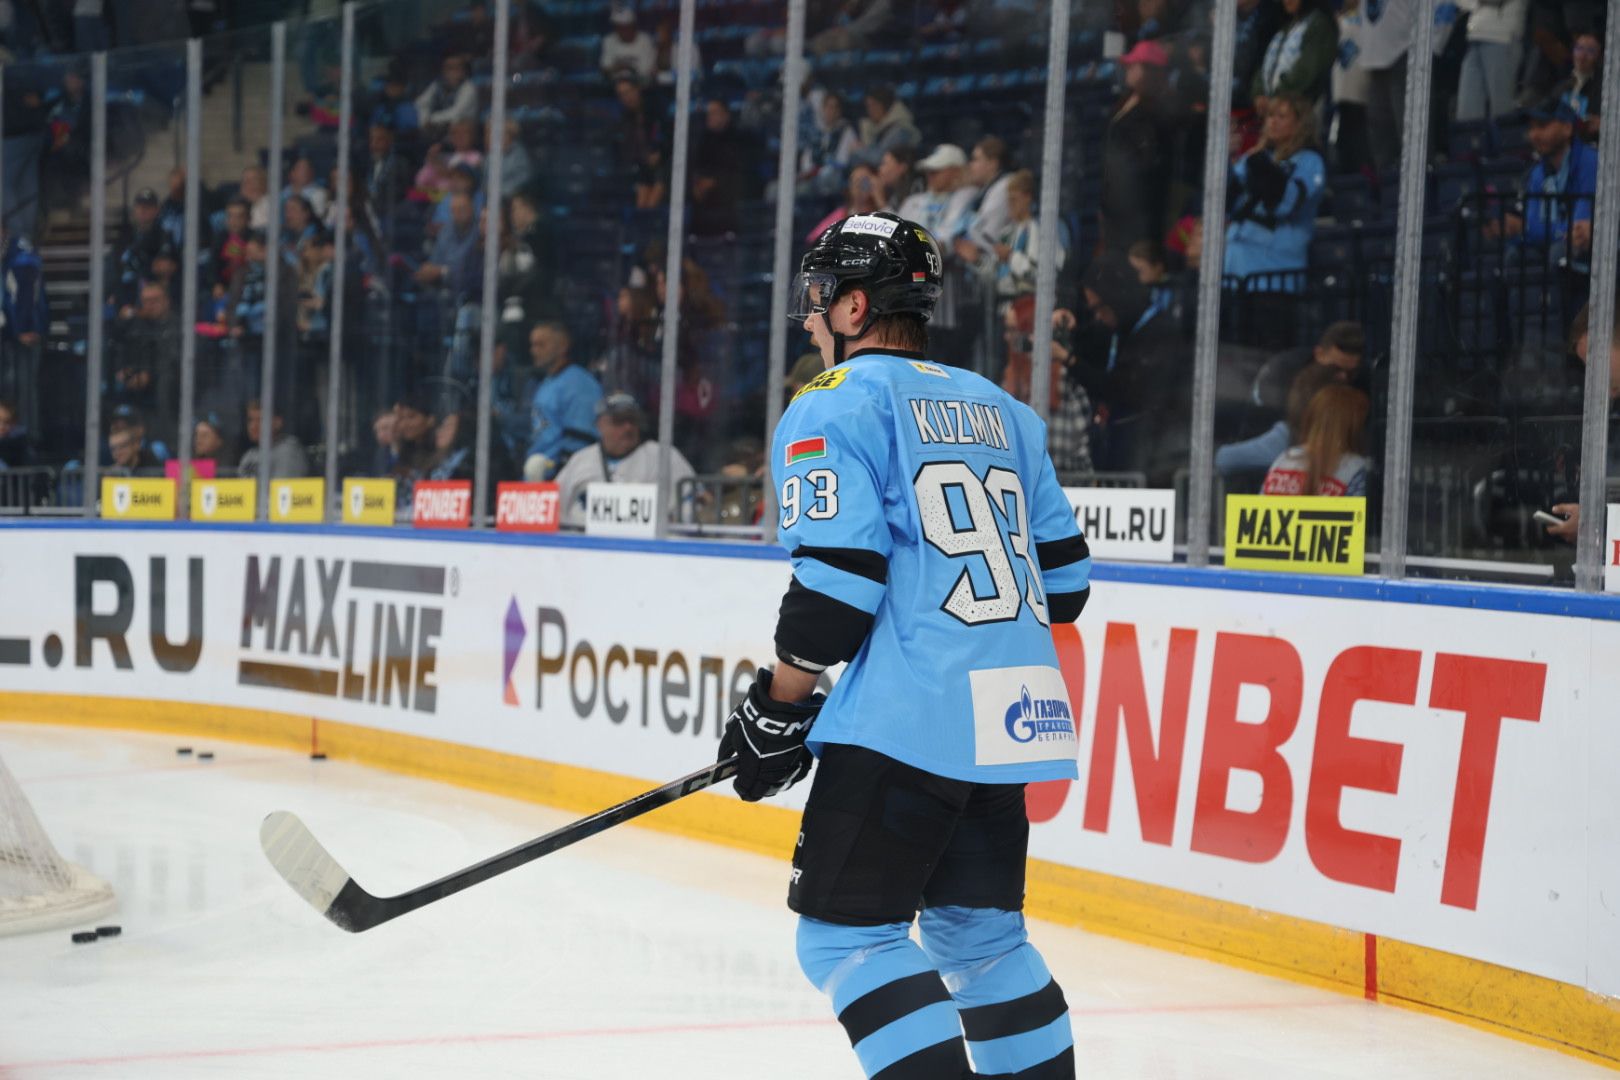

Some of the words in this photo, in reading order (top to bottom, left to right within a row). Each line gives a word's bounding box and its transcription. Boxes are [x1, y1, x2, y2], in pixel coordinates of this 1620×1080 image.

[844, 219, 894, 234] Belavia
[841, 258, 872, 266] CCM
[909, 398, 1009, 450] KUZMIN
[414, 488, 470, 521] FONBET
[498, 489, 558, 524] FONBET
[591, 498, 652, 524] KHL.RU
[782, 468, 838, 529] 93
[913, 460, 1050, 628] 93
[536, 606, 833, 740] Ростеле
